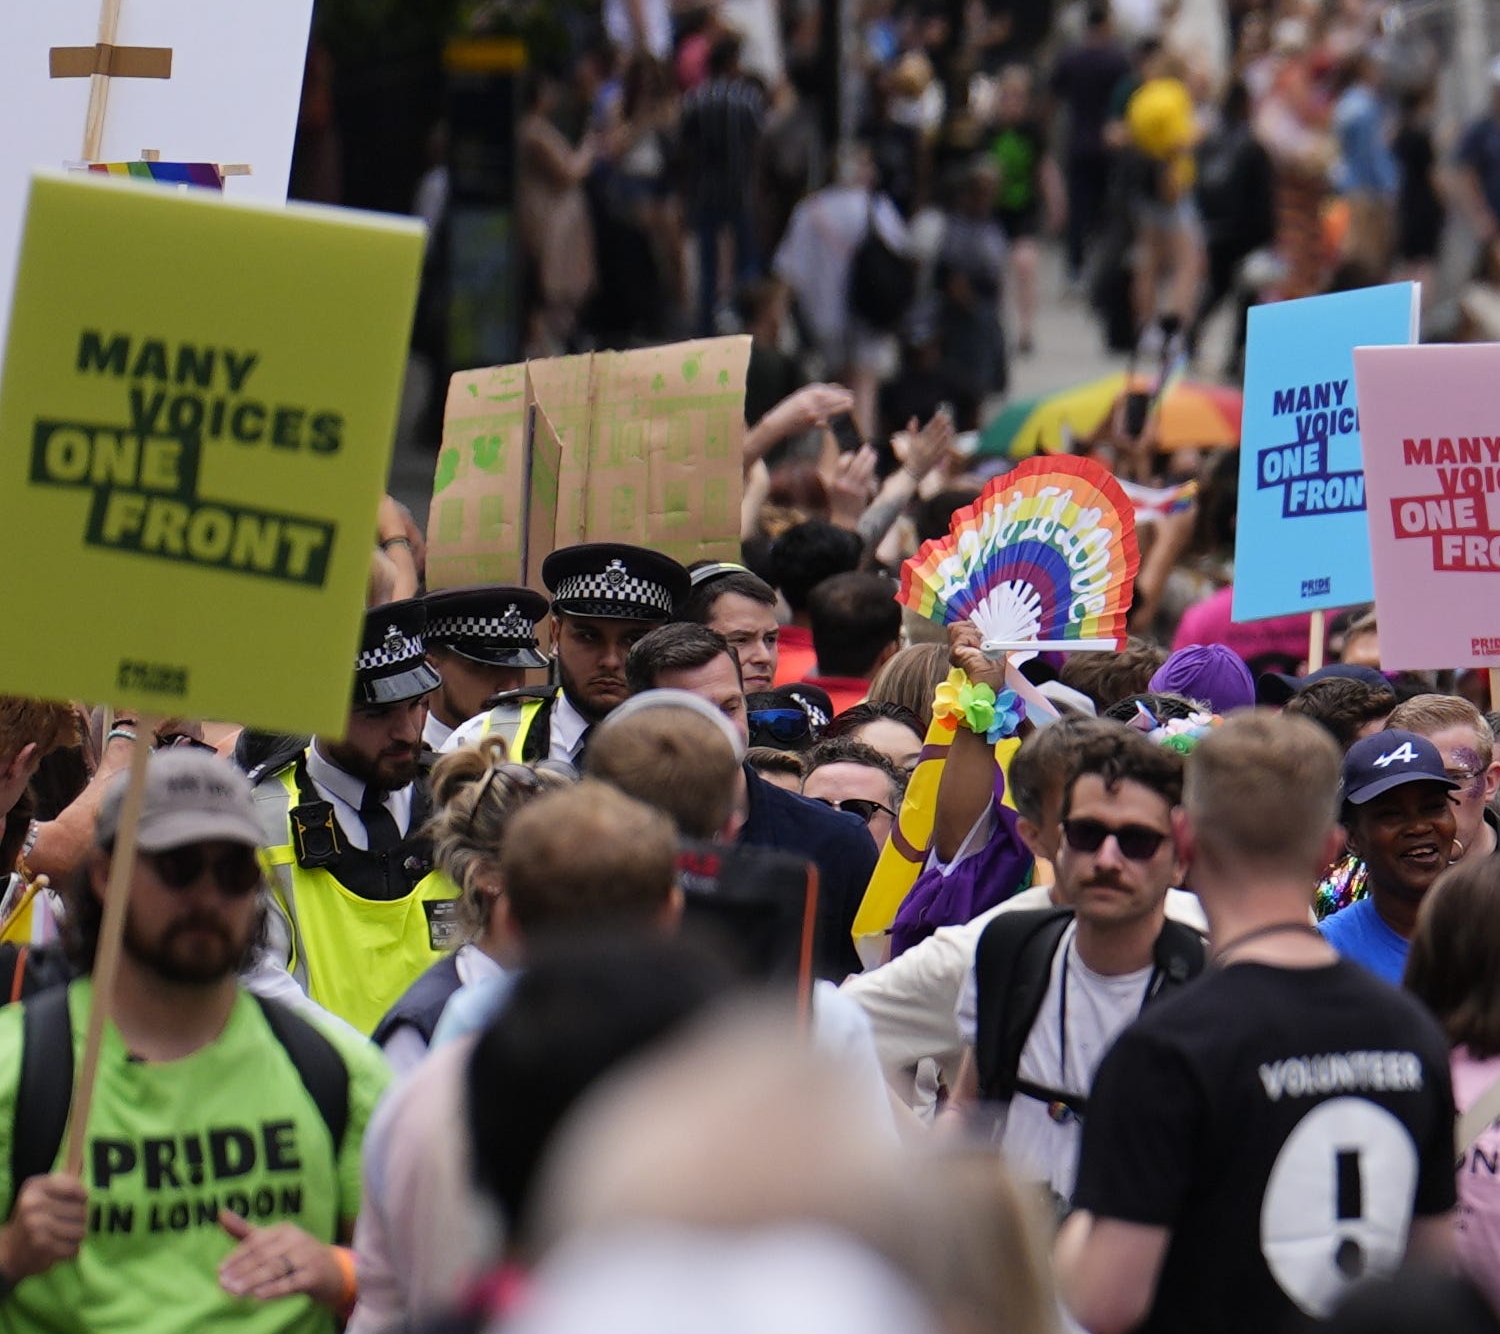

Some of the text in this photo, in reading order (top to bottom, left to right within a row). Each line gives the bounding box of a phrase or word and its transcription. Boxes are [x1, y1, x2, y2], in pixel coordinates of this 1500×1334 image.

[76, 327, 260, 394] MANY
[128, 380, 346, 458] VOICES
[1272, 379, 1349, 416] MANY
[1296, 407, 1361, 442] VOIC
[44, 427, 184, 493] ONE
[1262, 443, 1320, 484] ONE
[102, 488, 326, 576] FRONT
[1399, 497, 1477, 533] ONE
[1258, 1050, 1425, 1102] VOLUNTEER
[90, 1185, 303, 1235] IN LONDON
